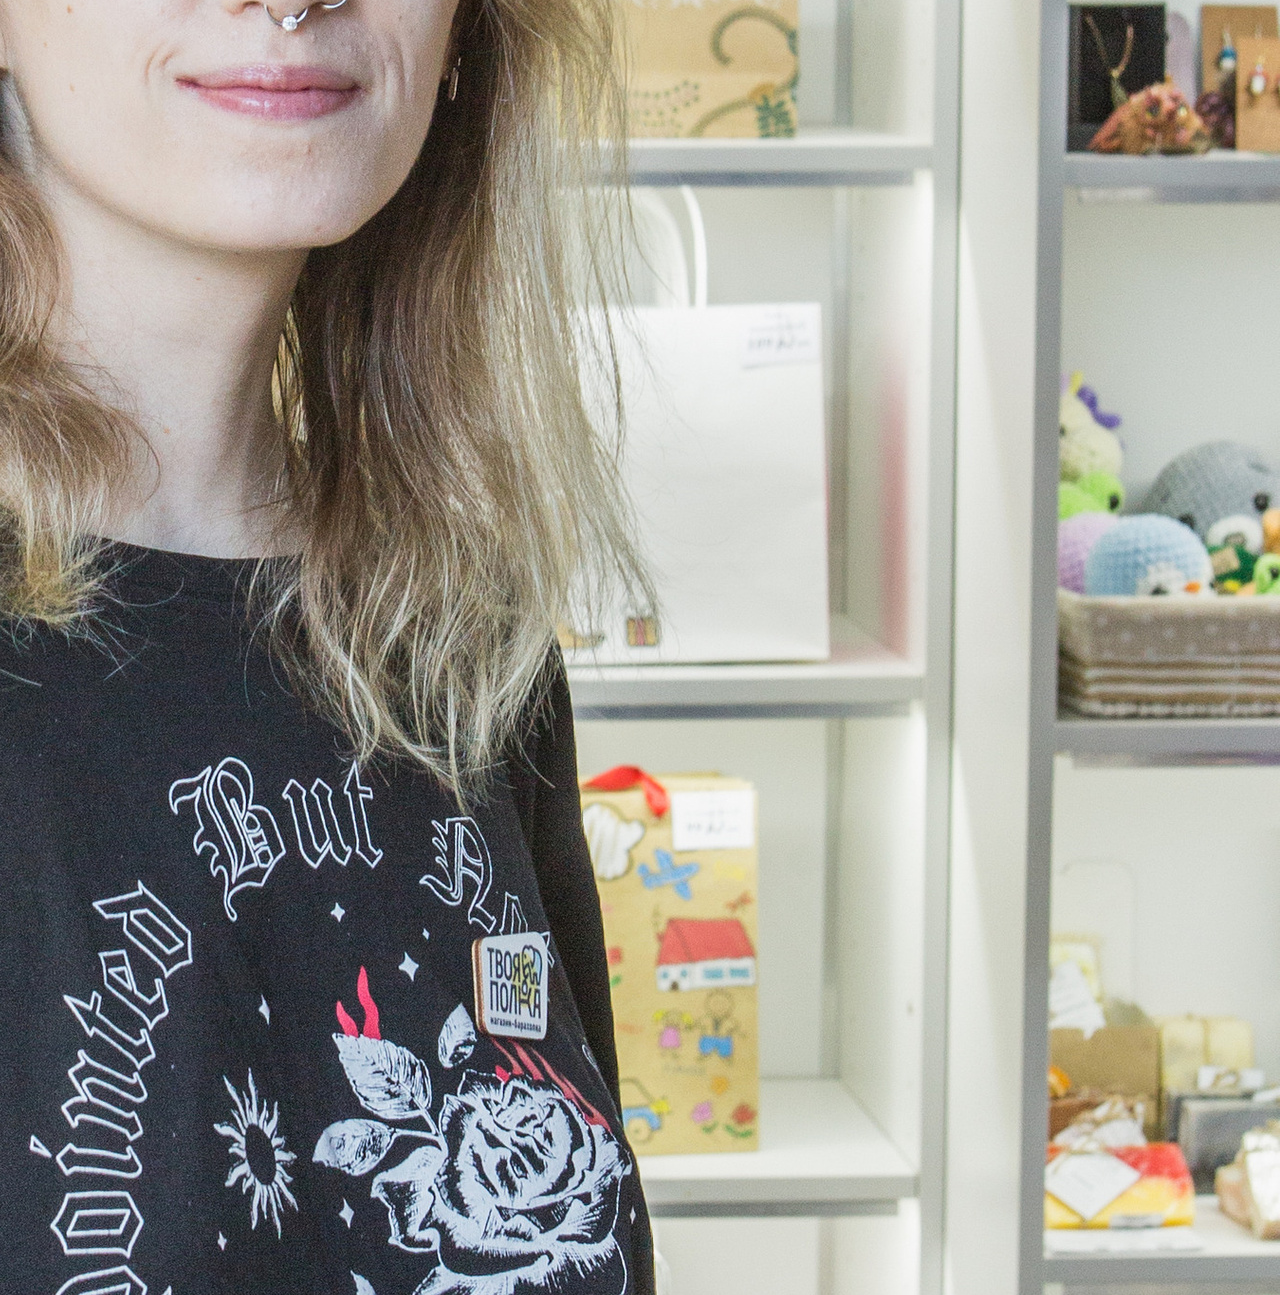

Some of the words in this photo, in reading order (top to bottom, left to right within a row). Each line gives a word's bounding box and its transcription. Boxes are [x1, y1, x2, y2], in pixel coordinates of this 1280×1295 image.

[168, 756, 384, 923] But
[486, 946, 521, 983] ТВОЯ
[489, 980, 542, 1019] ПОЛКА
